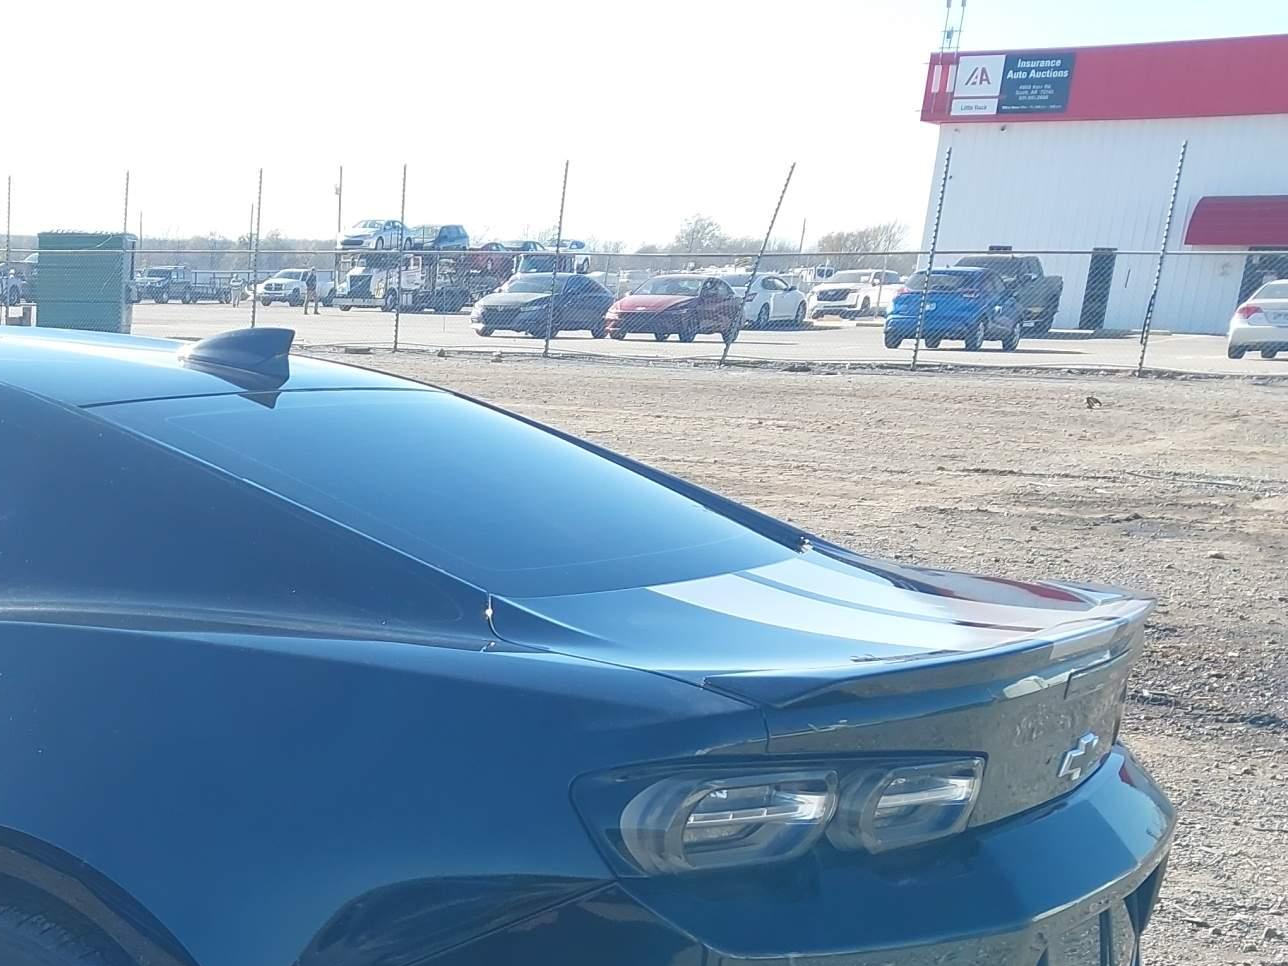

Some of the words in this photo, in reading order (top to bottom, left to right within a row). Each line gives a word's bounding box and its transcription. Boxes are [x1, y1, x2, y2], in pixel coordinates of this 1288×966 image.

[1017, 58, 1062, 69] Insurance
[1006, 69, 1028, 79] Auto
[1028, 69, 1069, 79] Auctions
